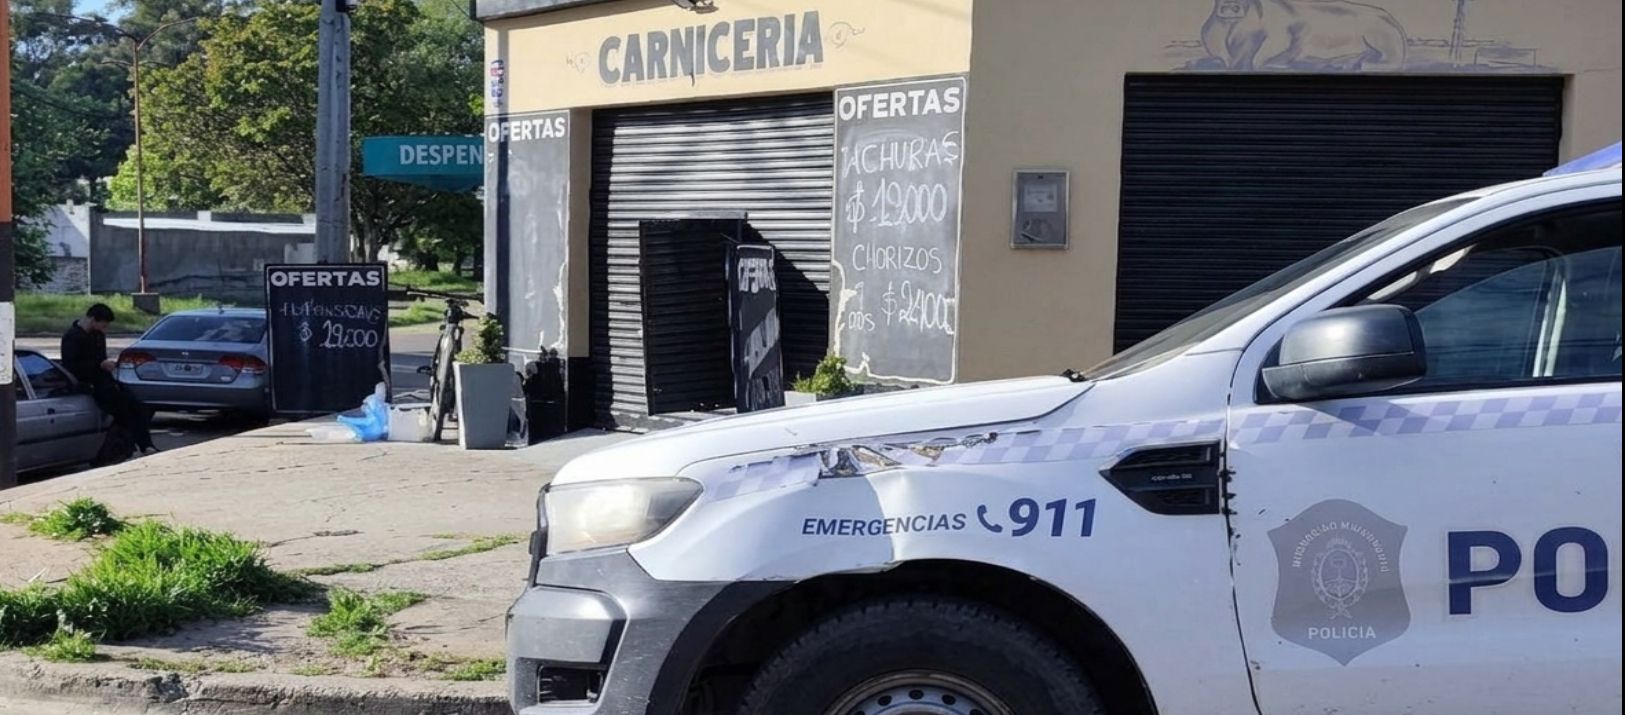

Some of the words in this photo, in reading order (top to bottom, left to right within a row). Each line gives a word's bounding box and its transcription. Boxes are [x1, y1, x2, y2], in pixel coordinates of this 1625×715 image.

[598, 10, 824, 86] CARNICERIA
[839, 86, 961, 121] OFERTAS
[487, 116, 567, 143] OFERTAS
[399, 143, 484, 166] DESPEN
[852, 243, 942, 274] CHORIZOS
[270, 270, 381, 287] OFERTAS
[802, 513, 968, 537] EMERGENCIAS
[1008, 498, 1097, 538] 911
[1448, 526, 1609, 616] PO
[1308, 626, 1377, 640] POLICIA
